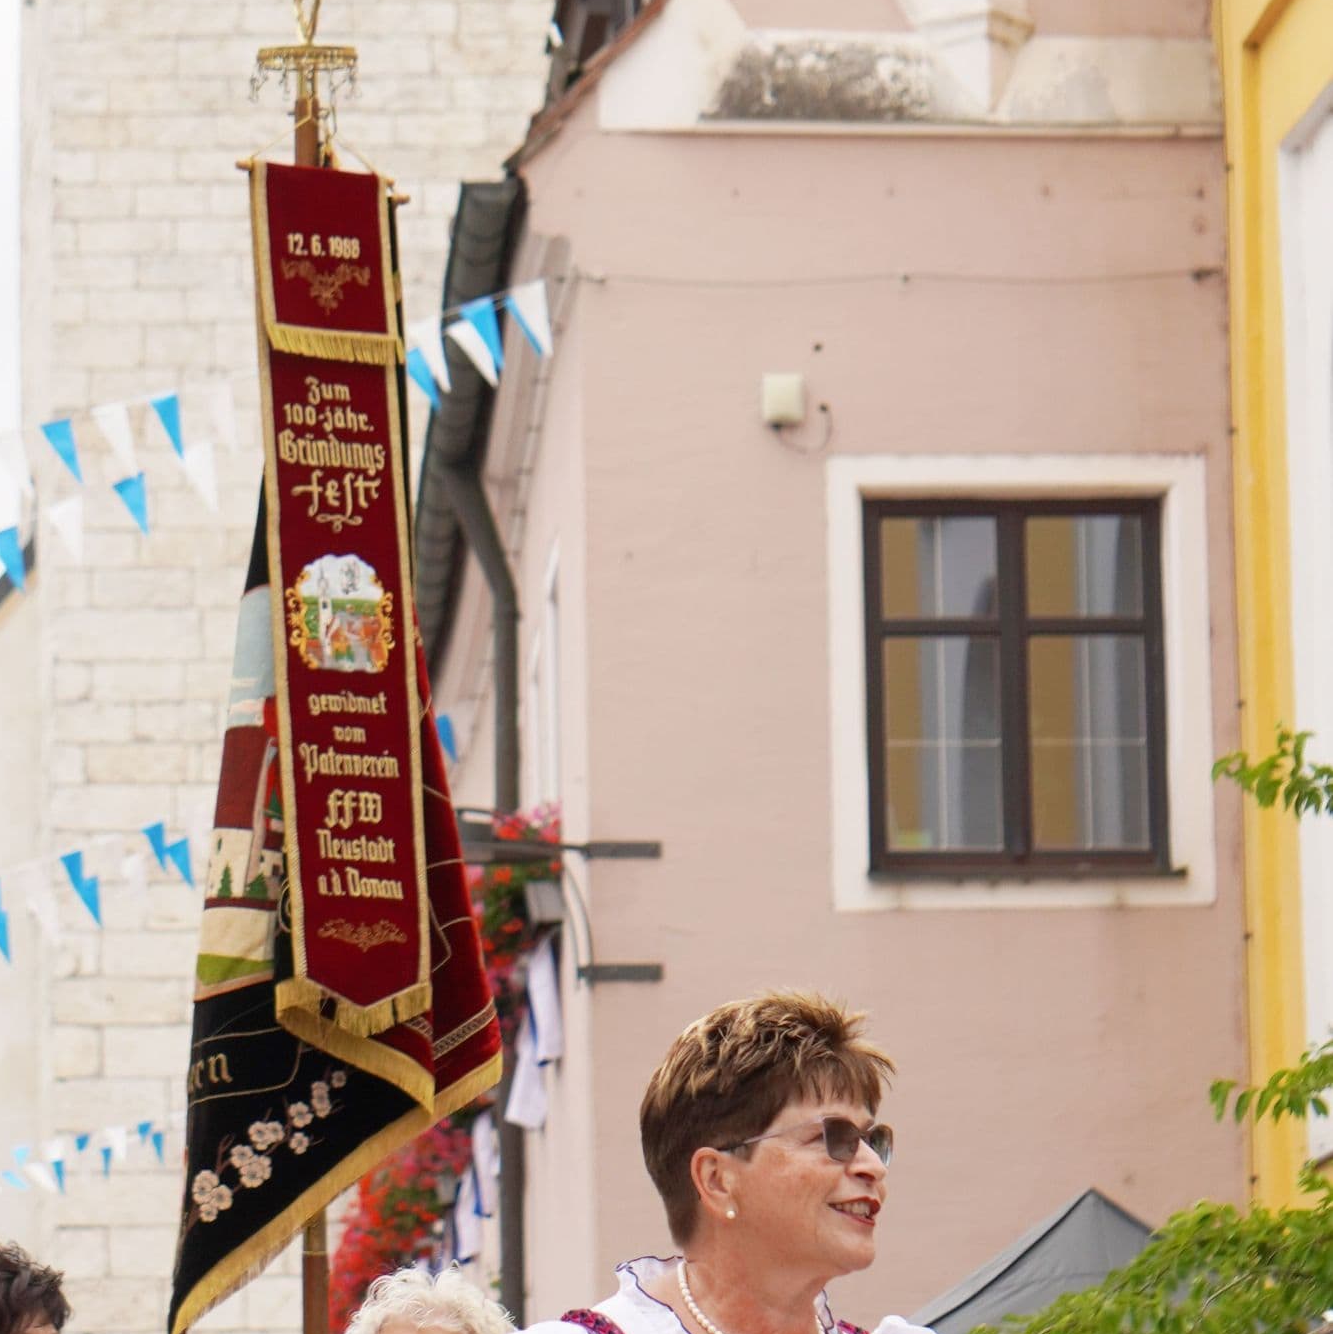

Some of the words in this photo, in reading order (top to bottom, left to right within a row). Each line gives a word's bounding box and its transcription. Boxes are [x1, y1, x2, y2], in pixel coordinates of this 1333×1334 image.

[287, 232, 309, 256] 12.
[310, 234, 326, 257] 6.
[328, 235, 361, 260] 1988
[304, 376, 351, 405] Zum
[308, 690, 387, 716] gewidmet
[332, 725, 367, 743] vom
[298, 742, 400, 783] Patenverein
[316, 828, 397, 864] Neustadt
[345, 866, 404, 900] Donau
